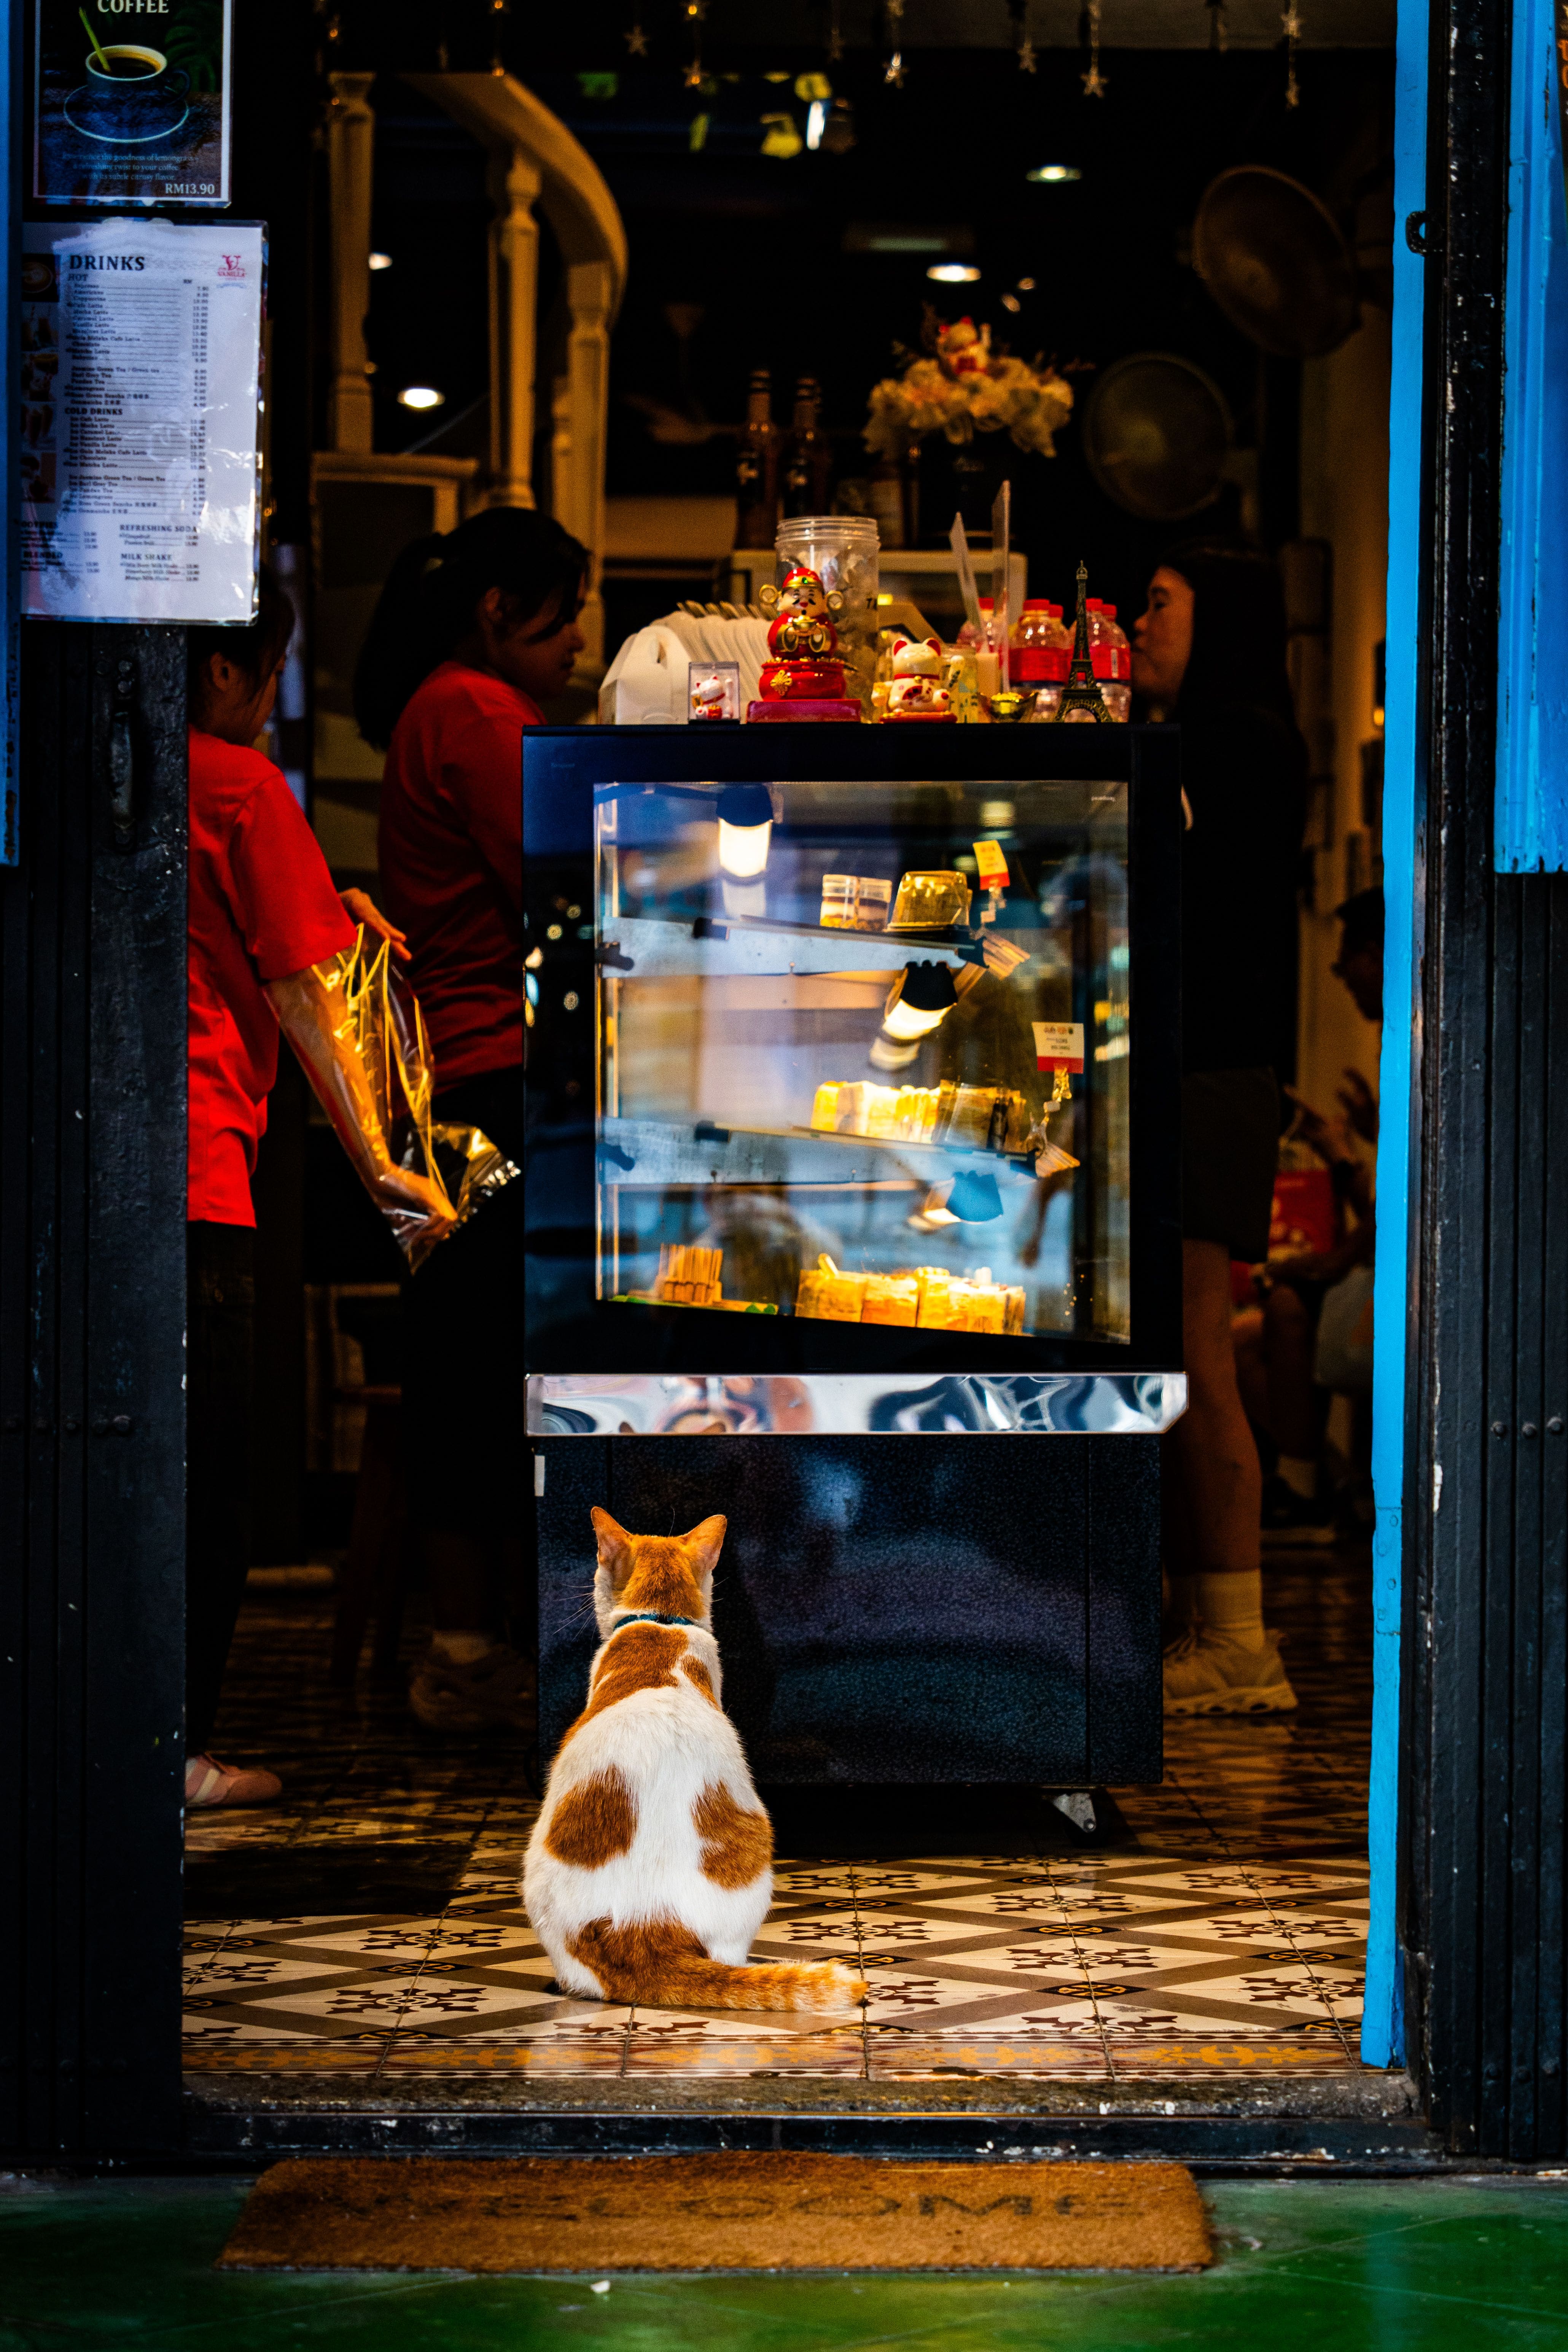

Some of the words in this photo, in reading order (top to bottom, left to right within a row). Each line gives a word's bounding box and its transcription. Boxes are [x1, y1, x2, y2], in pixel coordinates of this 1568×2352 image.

[97, 0, 169, 13] COFFEE
[114, 153, 145, 162] goodness
[165, 183, 215, 194] RM13.90
[70, 255, 145, 271] DRINKS
